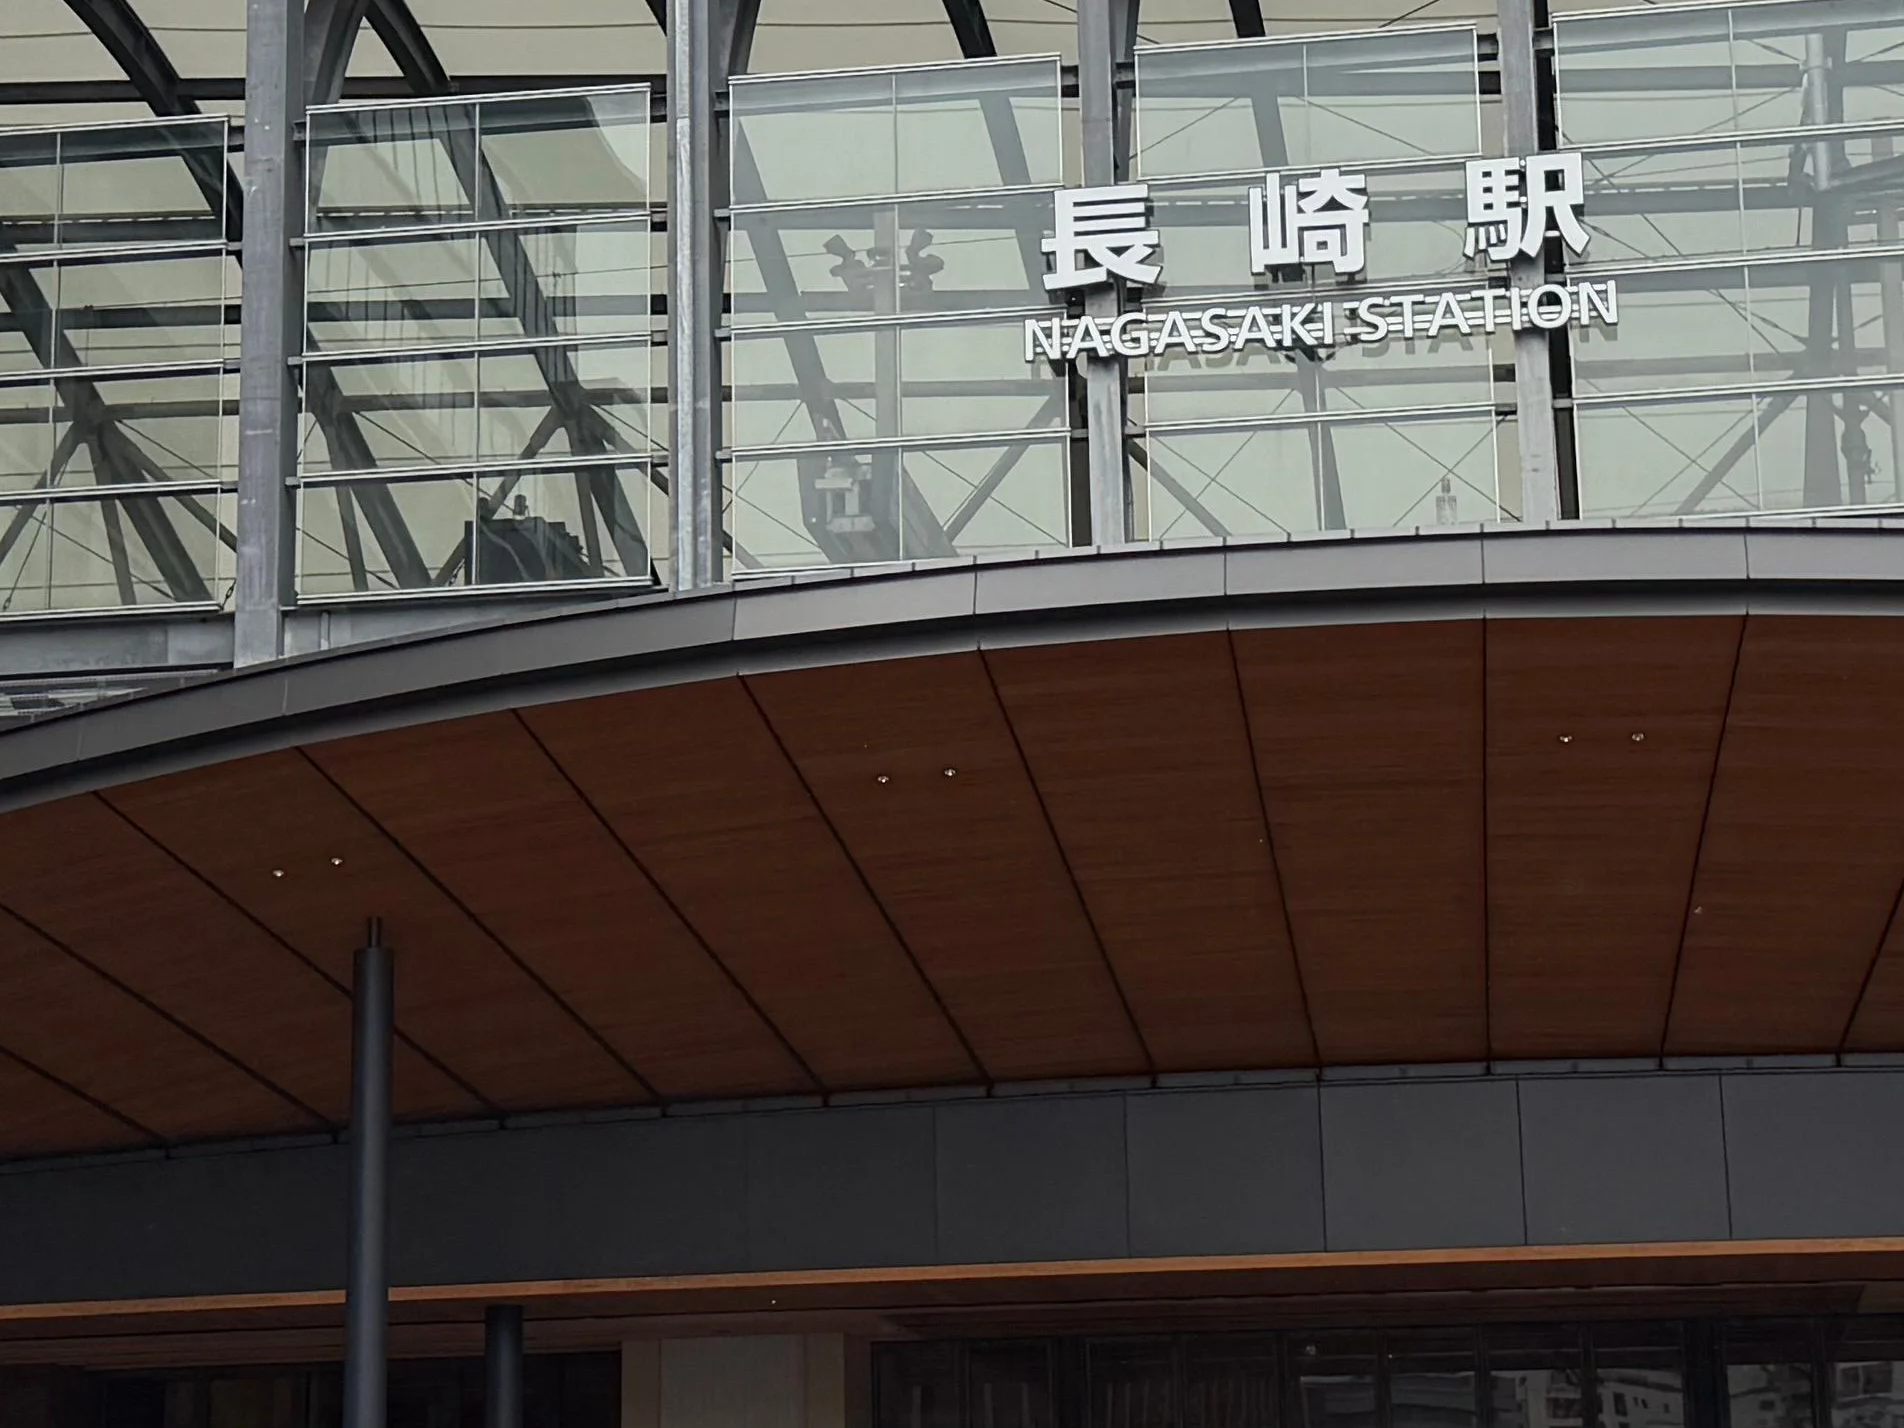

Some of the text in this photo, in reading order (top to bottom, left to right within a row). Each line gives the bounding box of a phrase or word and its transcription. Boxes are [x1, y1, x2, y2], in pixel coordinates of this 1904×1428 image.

[1040, 151, 1591, 291] 長崎駅
[1023, 279, 1618, 363] NAGASAKI STATION
